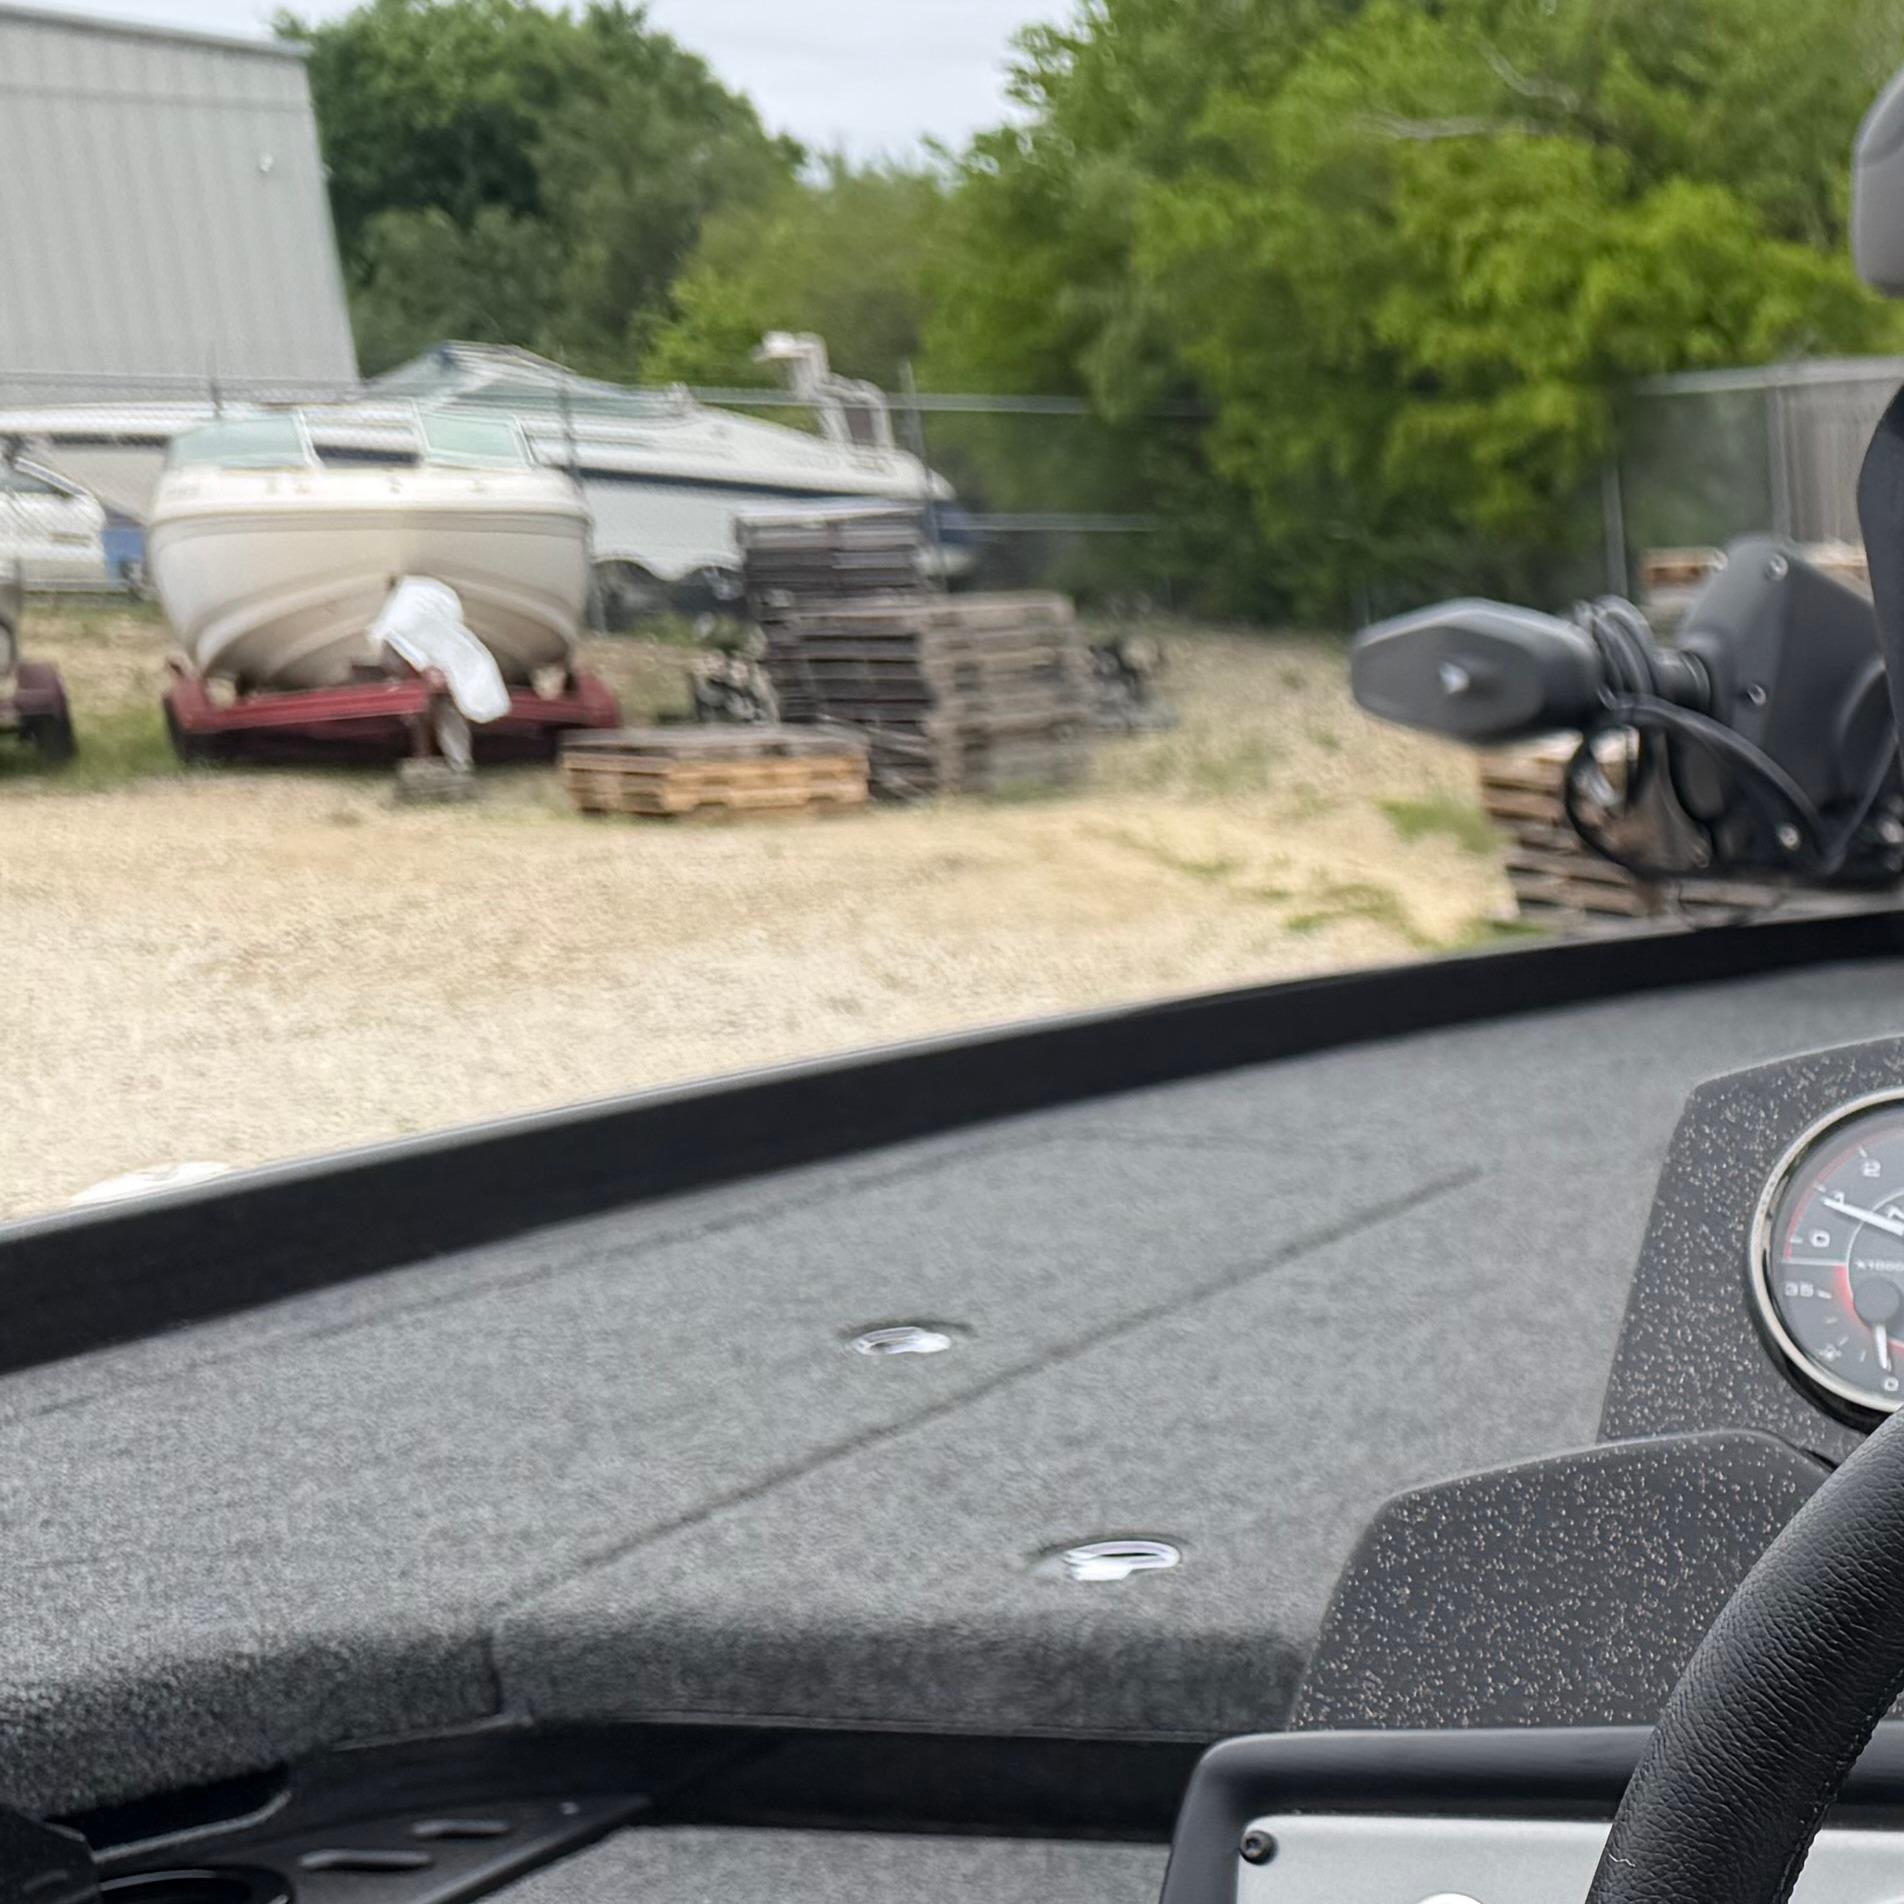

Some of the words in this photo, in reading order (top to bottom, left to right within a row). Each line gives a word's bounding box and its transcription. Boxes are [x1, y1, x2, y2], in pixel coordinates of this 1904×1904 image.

[1862, 1160, 1880, 1177] 2
[1811, 1230, 1831, 1248] 0
[1883, 1376, 1899, 1392] 0
